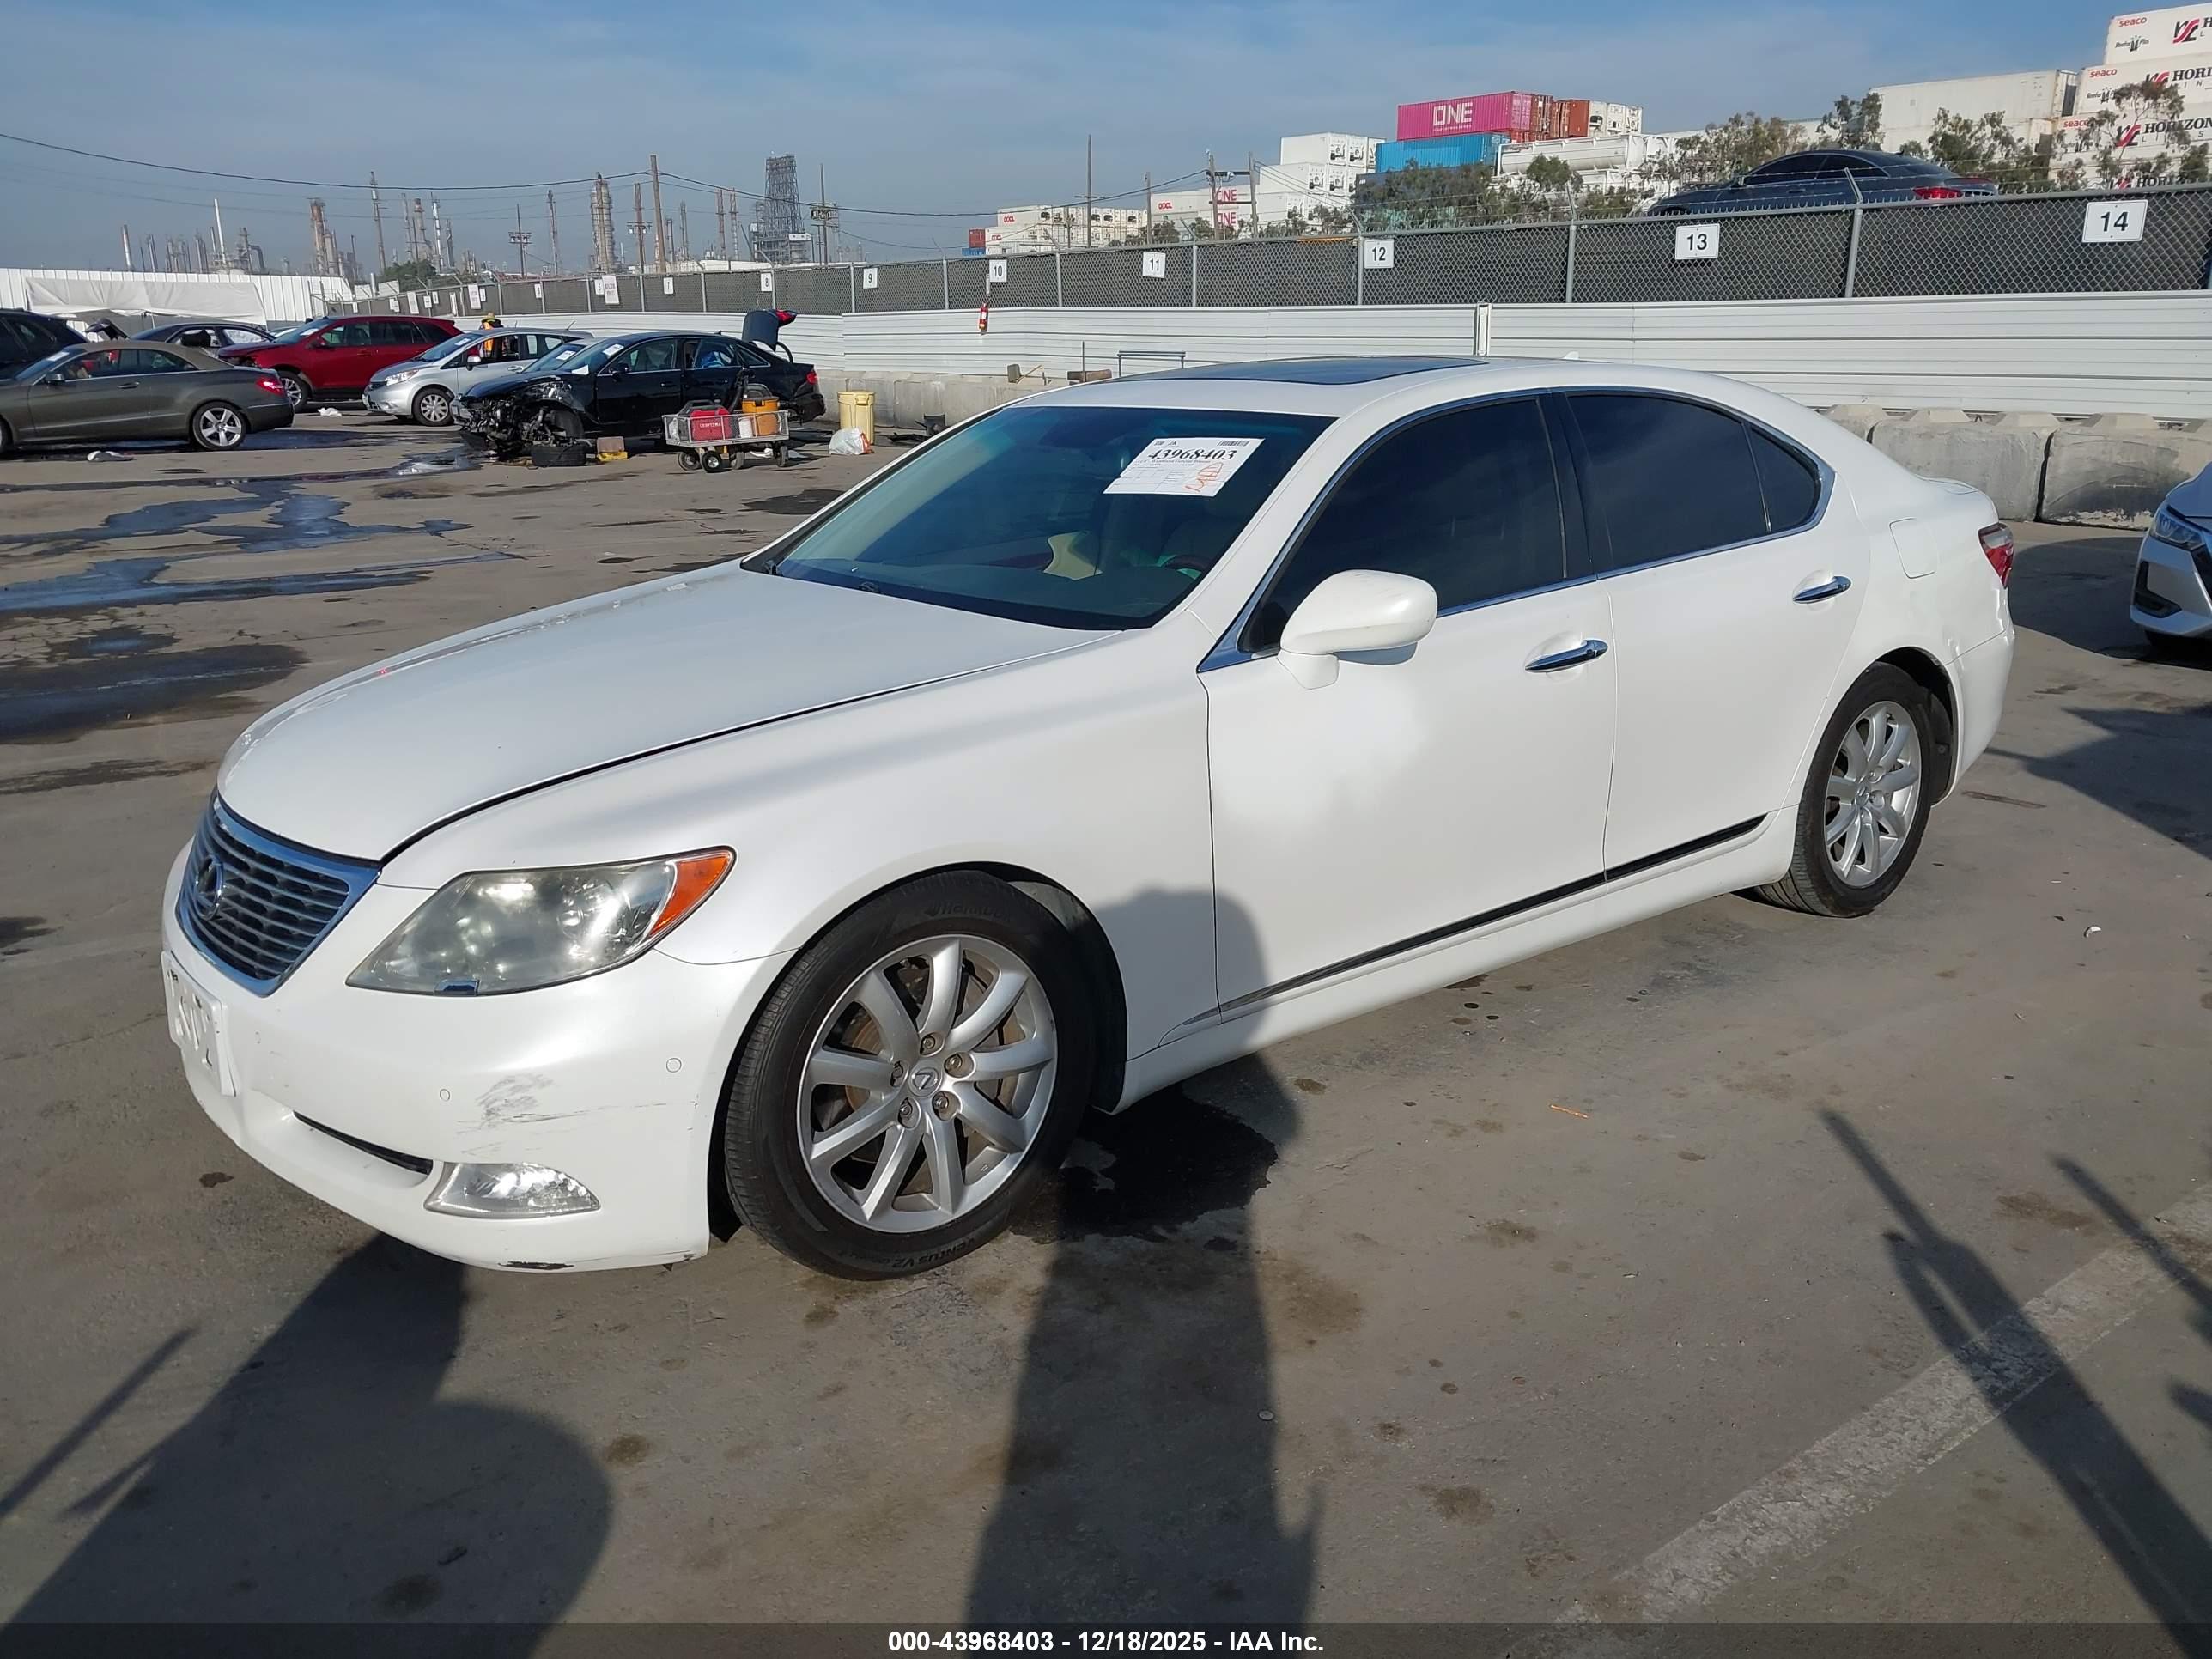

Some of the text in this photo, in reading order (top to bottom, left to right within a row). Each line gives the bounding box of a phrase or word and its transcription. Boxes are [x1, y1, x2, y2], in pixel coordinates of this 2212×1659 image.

[2118, 17, 2148, 27] seaco
[2089, 67, 2118, 78] seaco
[1433, 102, 1474, 126] ONE
[2100, 211, 2130, 232] 14
[1686, 233, 1708, 251] 13
[1371, 246, 1386, 262] 12
[994, 265, 1003, 276] 10
[1150, 258, 1160, 271] 11
[765, 277, 769, 288] 8
[867, 273, 872, 283] 9
[1148, 448, 1237, 460] 43968403
